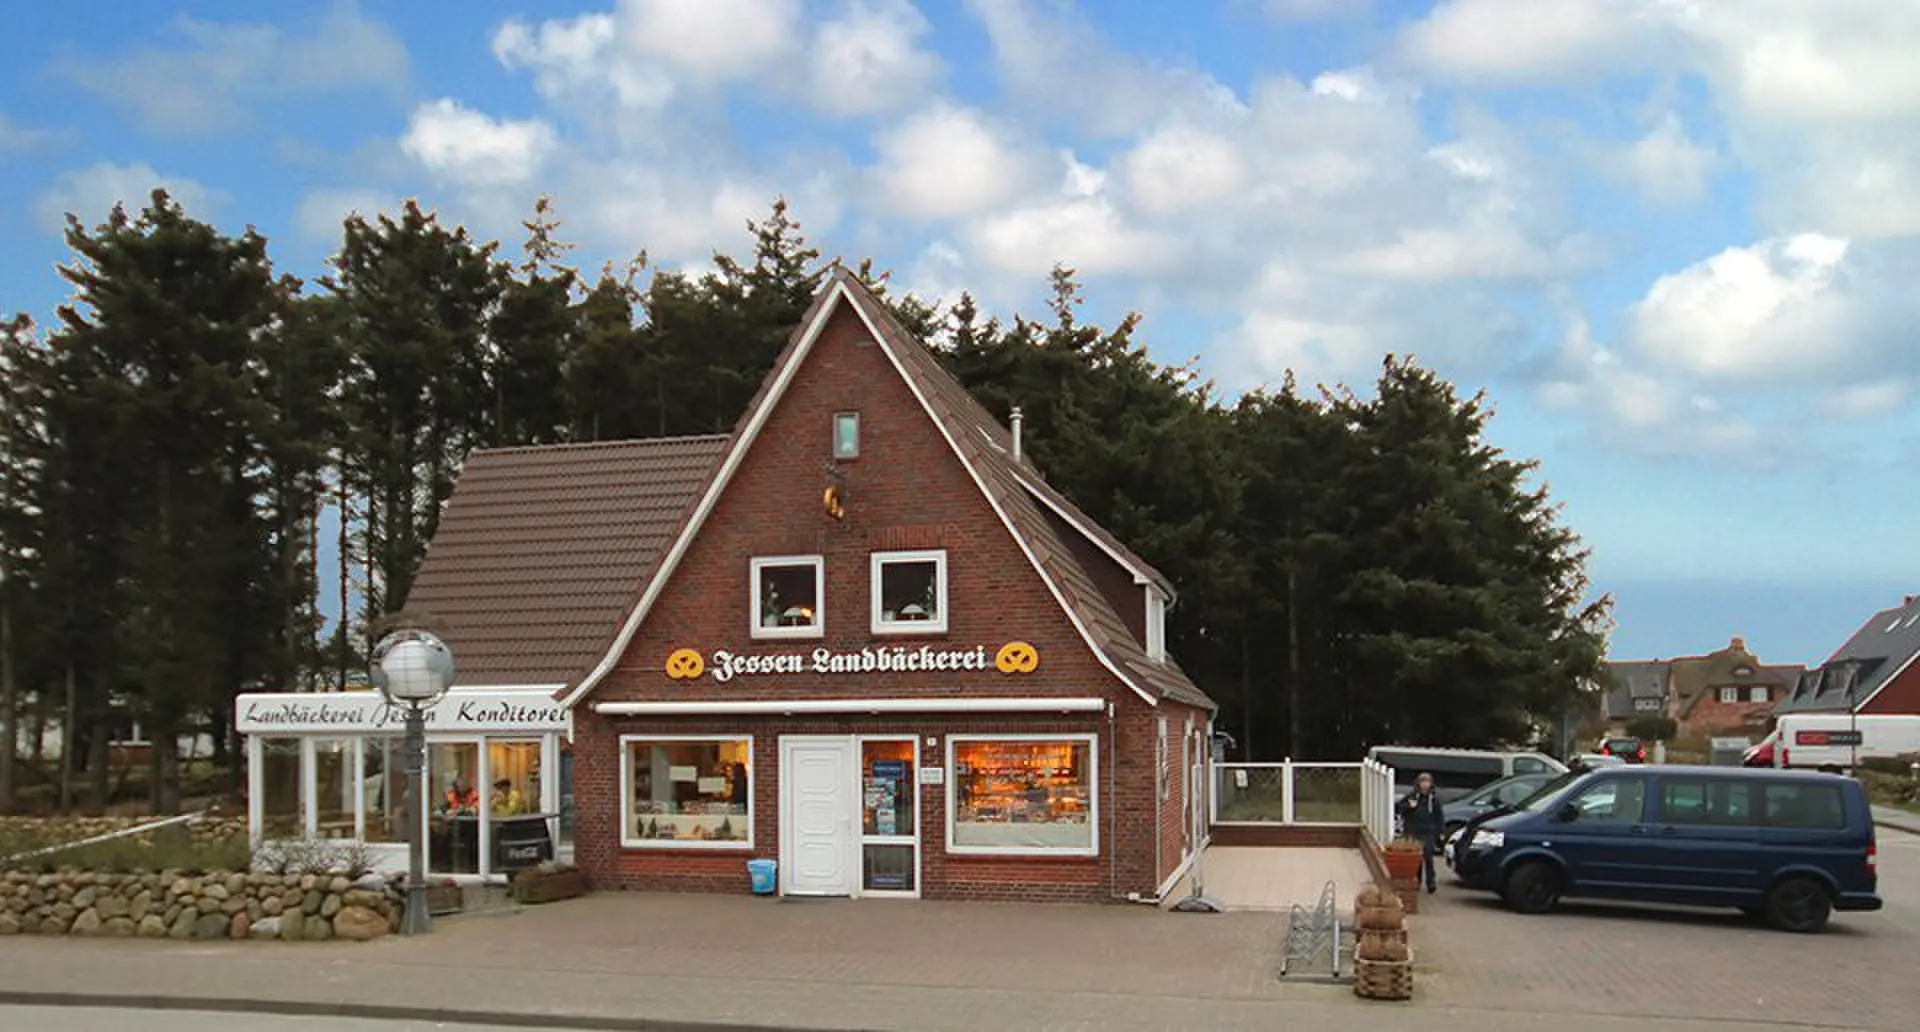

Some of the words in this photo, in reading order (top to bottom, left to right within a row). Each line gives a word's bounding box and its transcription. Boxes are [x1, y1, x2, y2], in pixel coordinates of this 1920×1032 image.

[712, 650, 803, 682] Jessen
[812, 646, 986, 673] Landbäckerei
[246, 703, 364, 723] Landbäckerei
[456, 702, 567, 722] Konditorei
